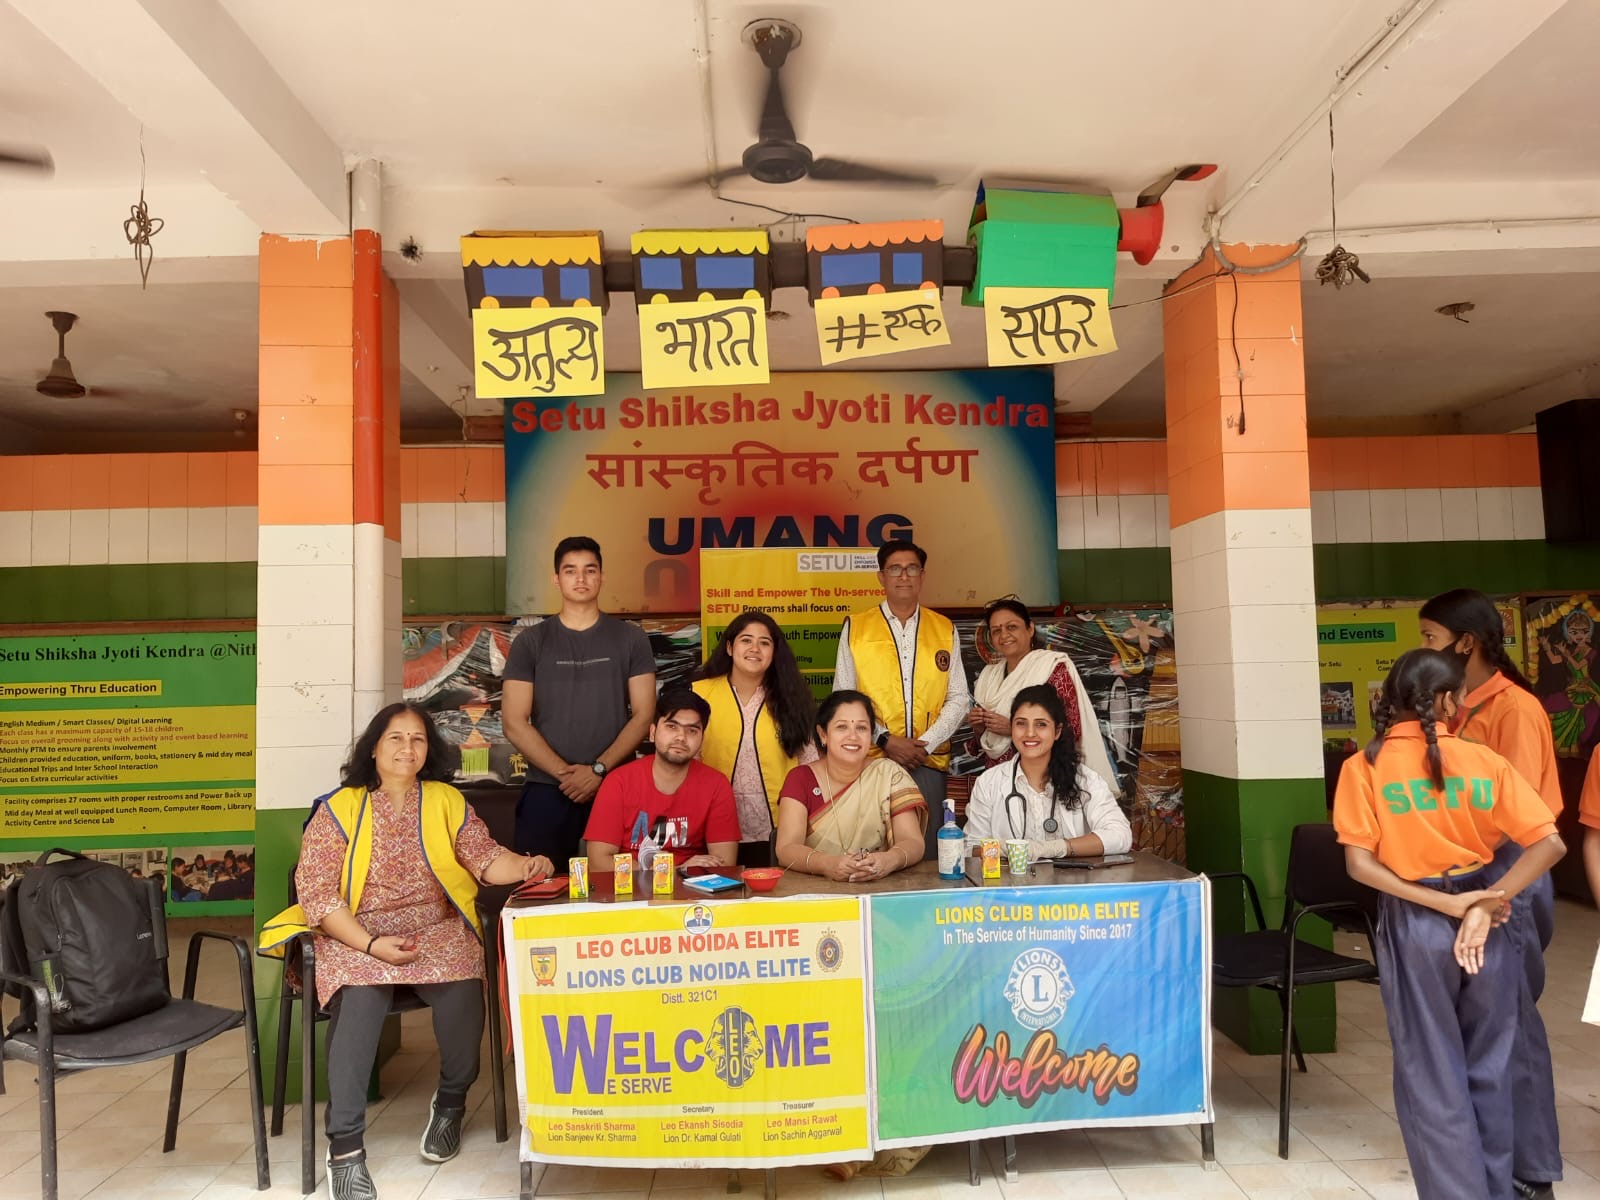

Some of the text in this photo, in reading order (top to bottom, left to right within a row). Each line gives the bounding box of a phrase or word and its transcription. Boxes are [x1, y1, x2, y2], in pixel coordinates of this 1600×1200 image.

[1000, 294, 1098, 358] सफर
[655, 306, 760, 372] भारत
[511, 390, 1050, 433] Setu Shiksha Jyoti Kendra
[585, 436, 979, 506] सांस्कृतिक दर्पण
[648, 513, 914, 556] UMANG
[799, 554, 847, 570] SETU
[706, 587, 887, 599] Skill and Empower The Un-served
[706, 604, 740, 613] SETU
[742, 604, 785, 614] Programs
[787, 603, 808, 613] shall
[810, 603, 833, 612] focus
[1340, 628, 1385, 640] Events
[0, 648, 30, 661] Setu
[35, 647, 97, 661] Shiksha
[102, 645, 140, 663] Jyoti
[145, 644, 205, 659] Kendra
[0, 683, 157, 696] Empowering Thru Education
[117, 717, 140, 726] Digital
[141, 717, 173, 725] Learning
[83, 745, 110, 753] parents
[29, 755, 61, 764] provided
[160, 752, 197, 760] stationery
[220, 751, 233, 759] day
[41, 765, 58, 773] Trips
[4, 797, 30, 806] Facility
[31, 796, 67, 805] comprises
[1382, 776, 1494, 815] SETU
[5, 809, 19, 817] Mid
[20, 809, 33, 818] day
[35, 808, 53, 816] Meal
[81, 807, 114, 816] equipped
[116, 806, 137, 814] Lunch
[163, 805, 199, 813] Computer
[227, 803, 252, 811] Library
[5, 819, 32, 827] Activity
[33, 818, 57, 826] Centre
[74, 817, 100, 825] Science
[102, 816, 115, 824] Lab
[935, 901, 1140, 925] LIONS CLUB NOIDA ELITE
[943, 923, 1132, 945] In The Service of Humanity Since 2017
[576, 929, 800, 960] LEO CLUB NOIDA ELITE
[1018, 951, 1059, 971] LIONS
[566, 957, 811, 989] LIONS CLUB NOIDA ELITE
[1031, 974, 1049, 1002] L
[661, 989, 719, 1005] Distt. 321C1
[952, 1023, 1141, 1109] Welcome
[622, 1076, 673, 1094] SERVE
[572, 1107, 604, 1116] President
[682, 1105, 715, 1115] Secretary
[782, 1101, 815, 1111] Treasurer
[548, 1122, 636, 1132] Leo Sanskriti Sharma
[660, 1119, 744, 1131] Leo Ekansh Sisodia
[766, 1113, 837, 1129] Leo Mansi Rawat
[548, 1133, 563, 1142] Lion
[565, 1133, 593, 1144] Sanjeev
[607, 1133, 637, 1142] Sharma
[663, 1131, 741, 1143] Lion Dr. Kamal Gulati
[763, 1126, 842, 1142] Lion Sachin Aggarwal
